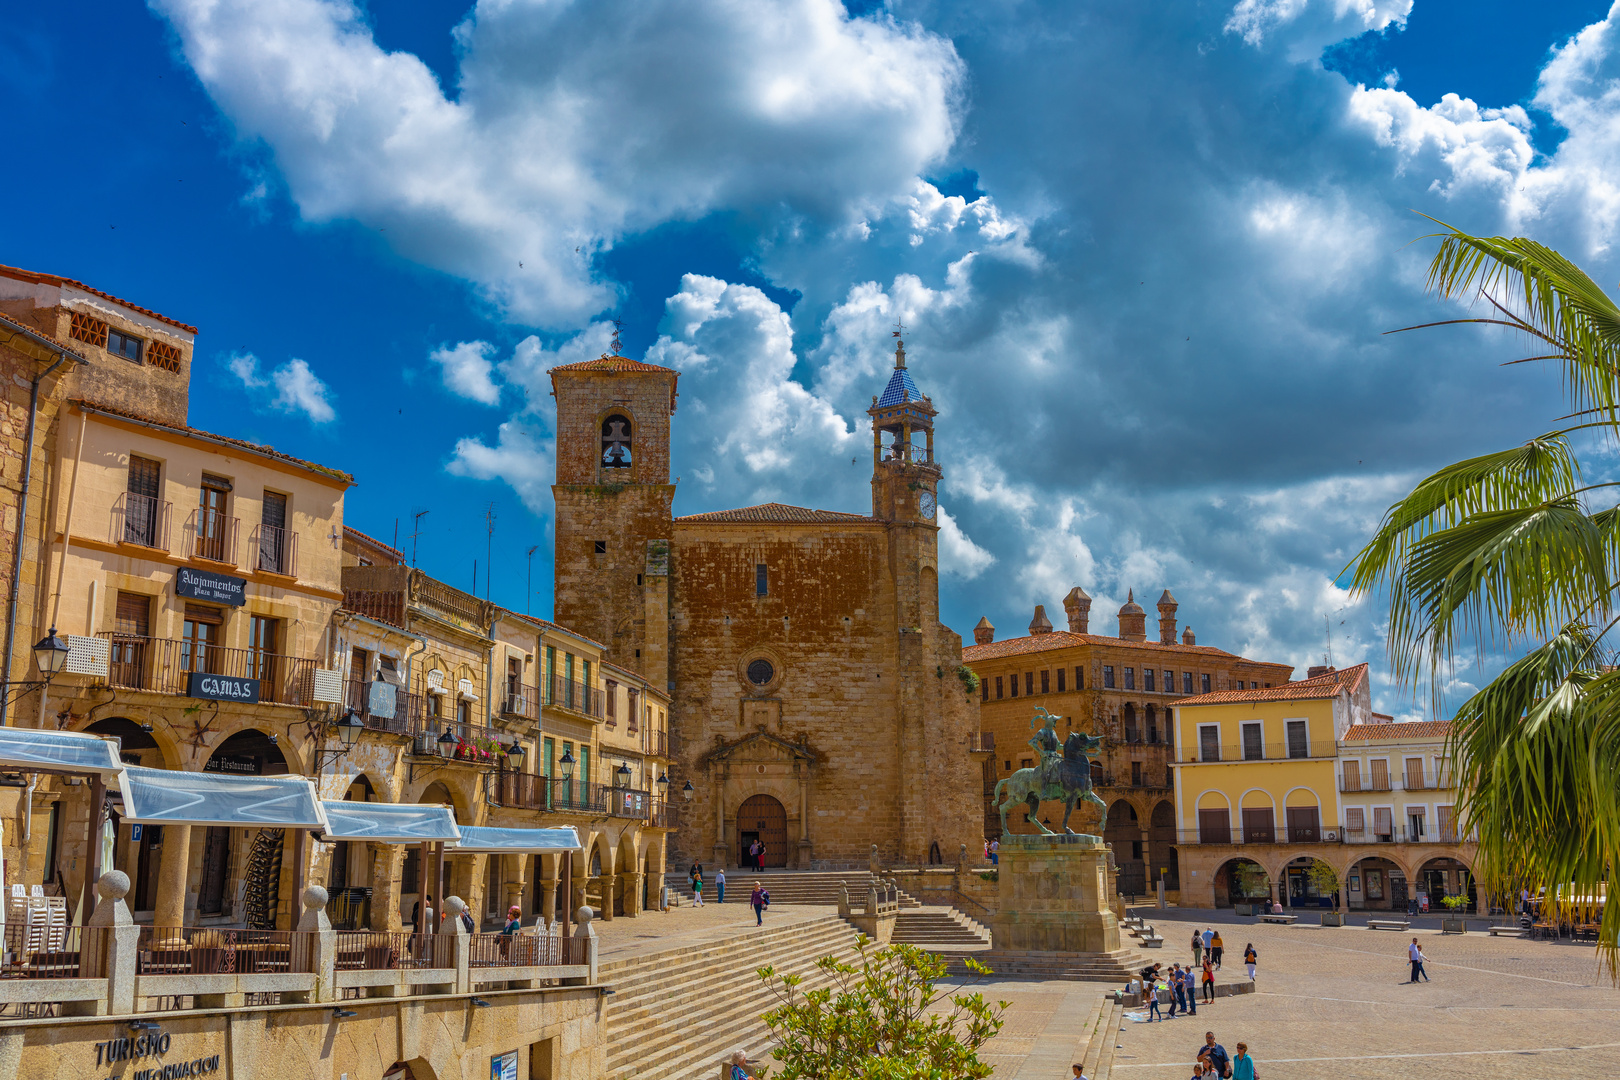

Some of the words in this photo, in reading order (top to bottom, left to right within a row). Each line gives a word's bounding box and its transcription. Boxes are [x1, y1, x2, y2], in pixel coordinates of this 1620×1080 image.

[181, 570, 242, 594] Alojamientos
[194, 586, 211, 596] Plaza
[200, 677, 252, 698] CAMAS
[95, 1032, 171, 1065] TURISMO
